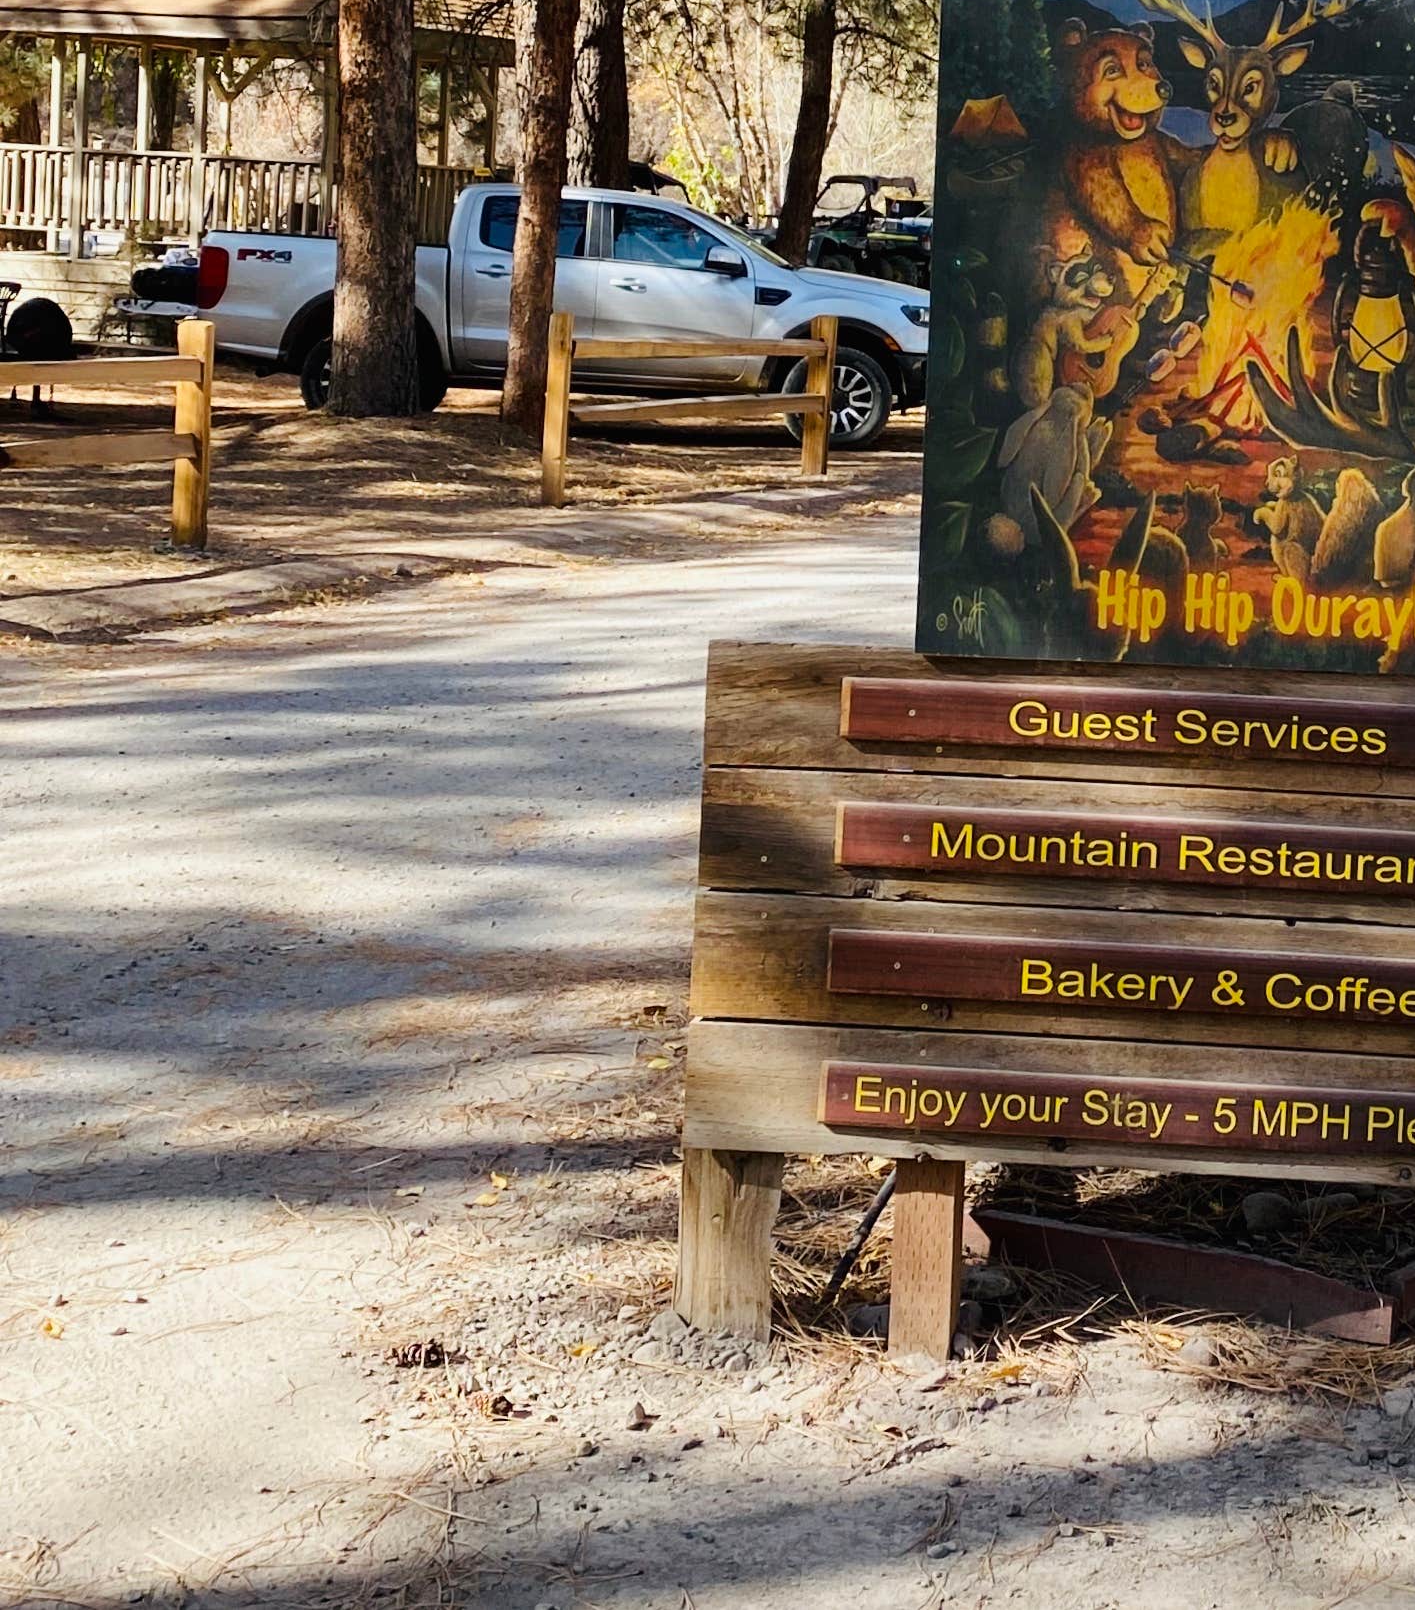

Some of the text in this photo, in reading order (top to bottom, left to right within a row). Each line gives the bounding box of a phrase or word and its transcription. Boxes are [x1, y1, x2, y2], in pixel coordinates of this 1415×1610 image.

[1096, 568, 1167, 643] Hip
[1184, 572, 1254, 646] Hip
[1009, 700, 1387, 755] Guest Services
[931, 822, 1157, 869] Mountain
[1021, 958, 1194, 1009] Bakery
[1211, 970, 1245, 1006] &
[854, 1076, 967, 1127] Enjoy
[980, 1092, 1068, 1129] your
[1082, 1089, 1173, 1139] Stay
[1213, 1097, 1238, 1134] 5
[1252, 1099, 1350, 1140] MPH
